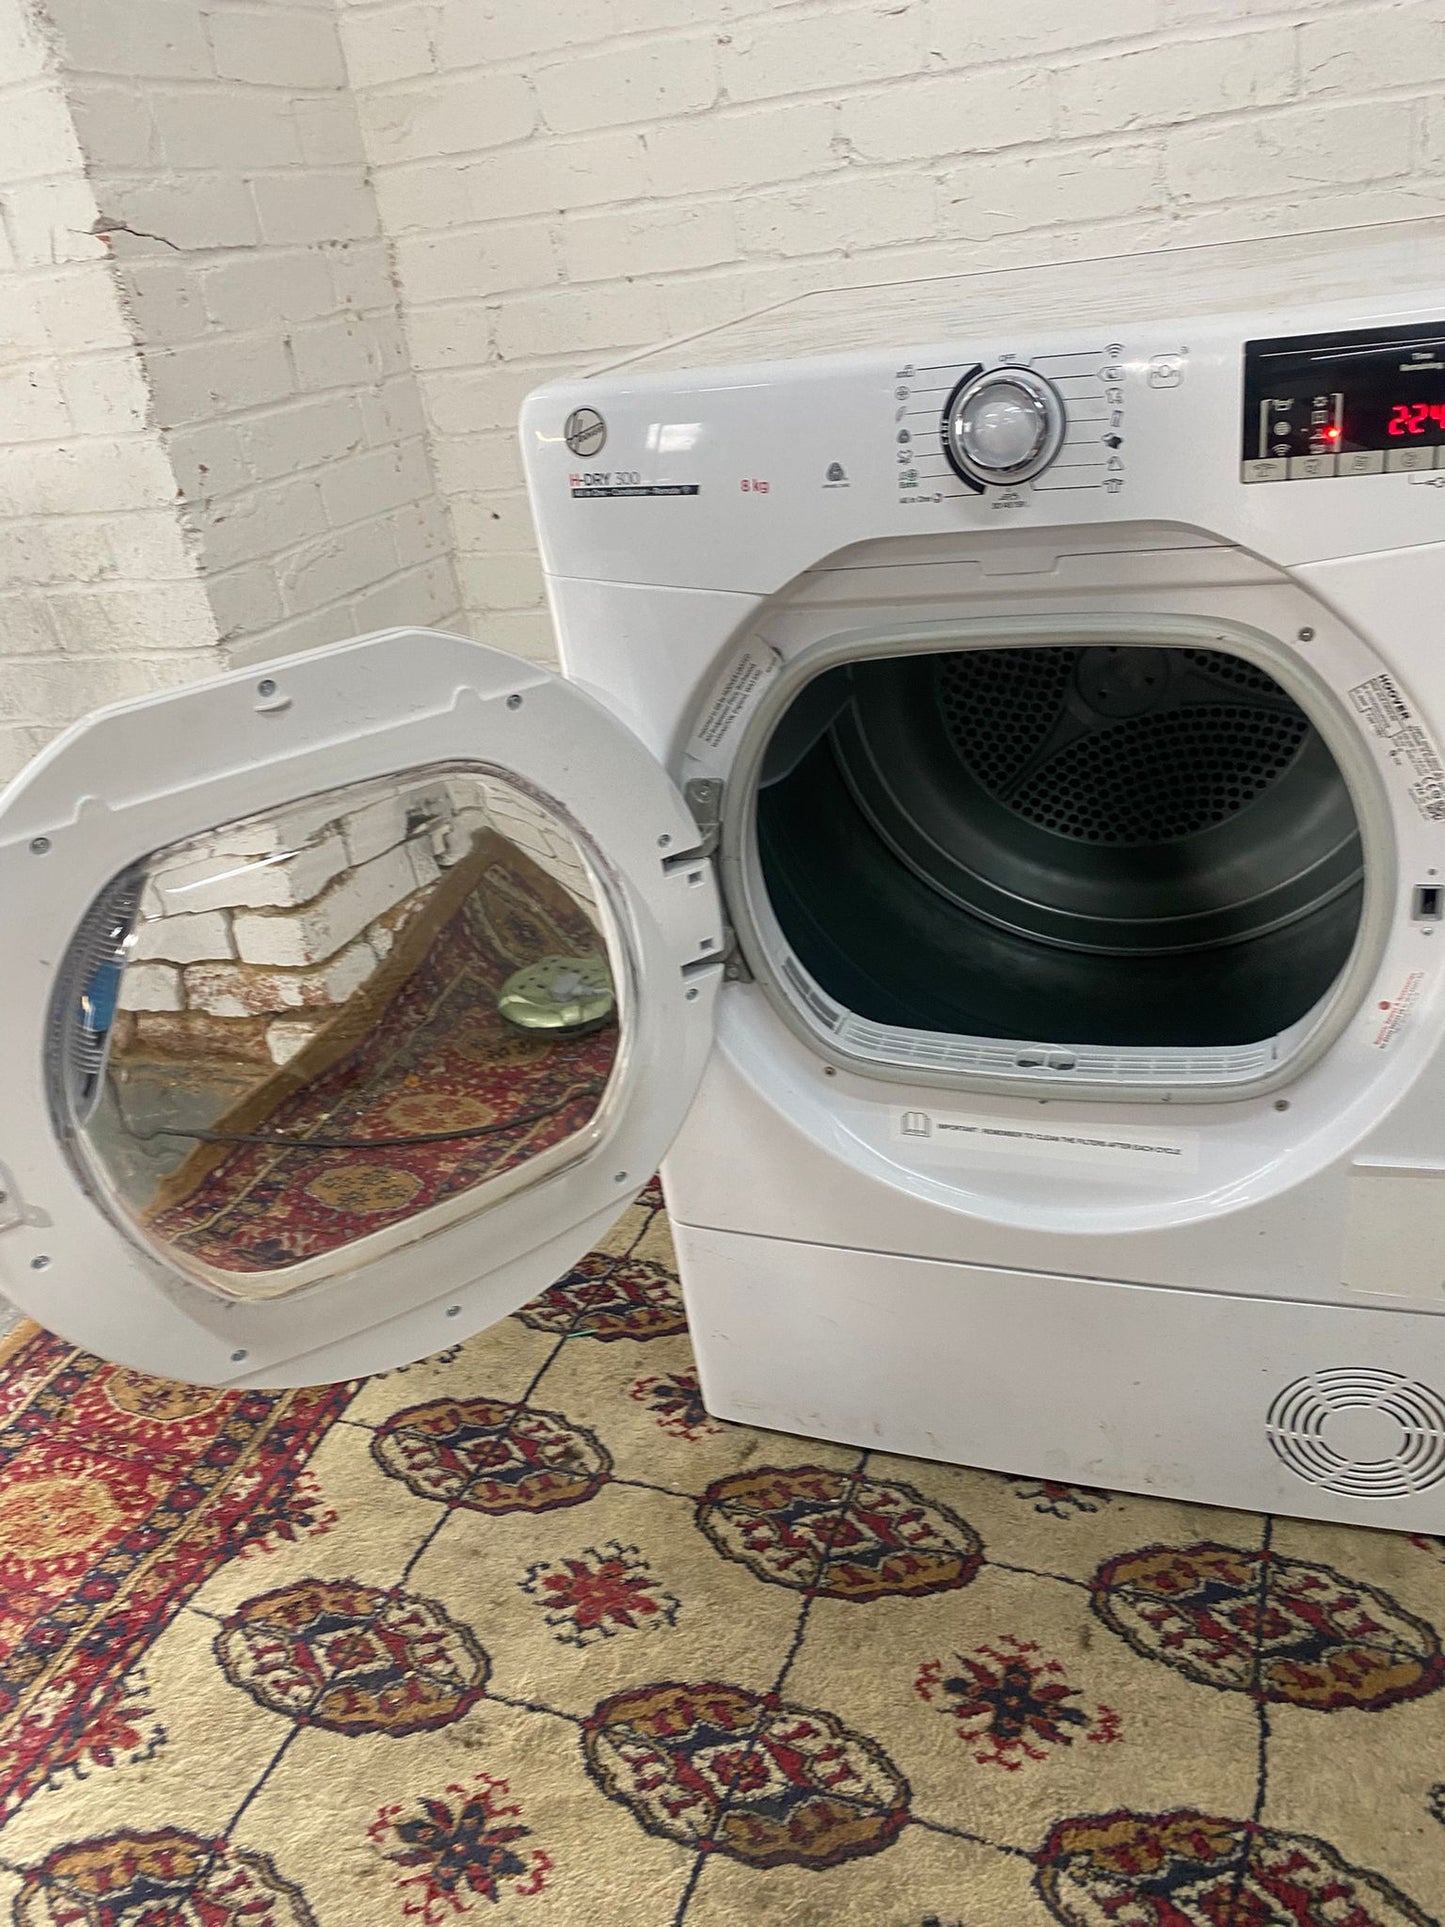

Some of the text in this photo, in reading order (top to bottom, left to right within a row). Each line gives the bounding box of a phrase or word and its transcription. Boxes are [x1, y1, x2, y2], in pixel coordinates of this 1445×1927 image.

[569, 471, 641, 487] H-DRY 300
[740, 478, 769, 494] 8 kg
[1378, 673, 1411, 719] HOOVER
